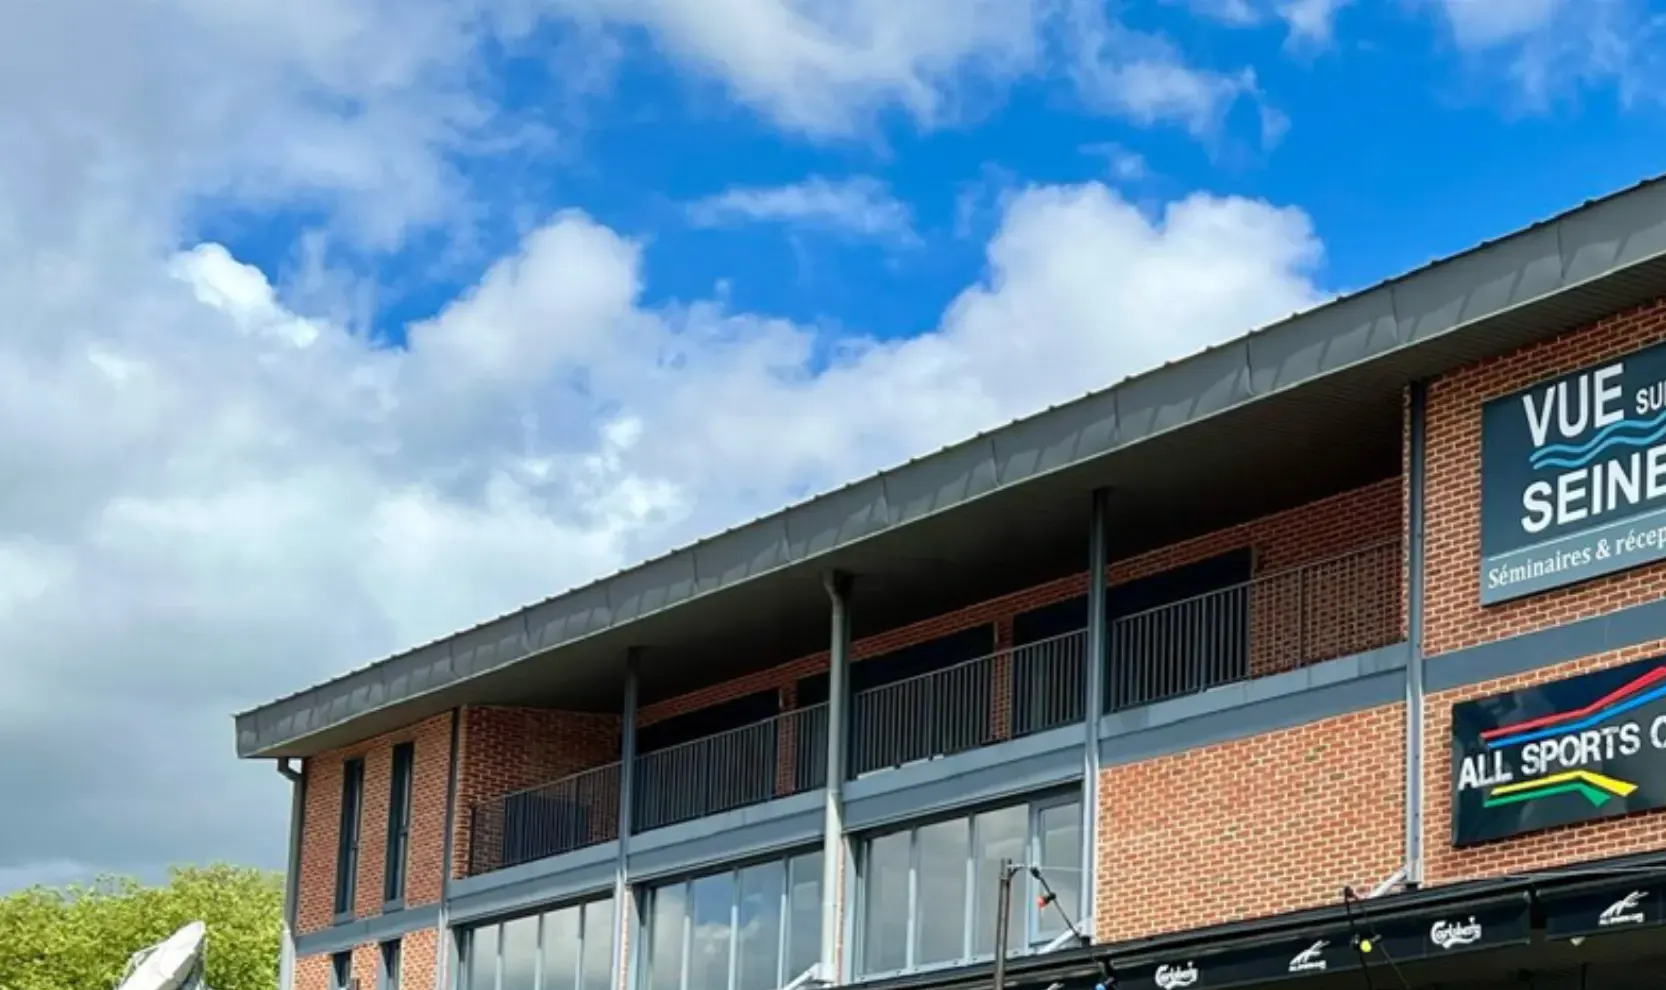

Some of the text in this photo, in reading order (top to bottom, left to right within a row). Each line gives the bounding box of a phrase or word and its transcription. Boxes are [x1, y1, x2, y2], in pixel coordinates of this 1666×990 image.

[1523, 362, 1625, 448] VUE
[1487, 546, 1591, 590] Séminaires
[1595, 538, 1611, 560] &
[1457, 751, 1513, 792] ALL
[1521, 723, 1641, 776] SPORTS
